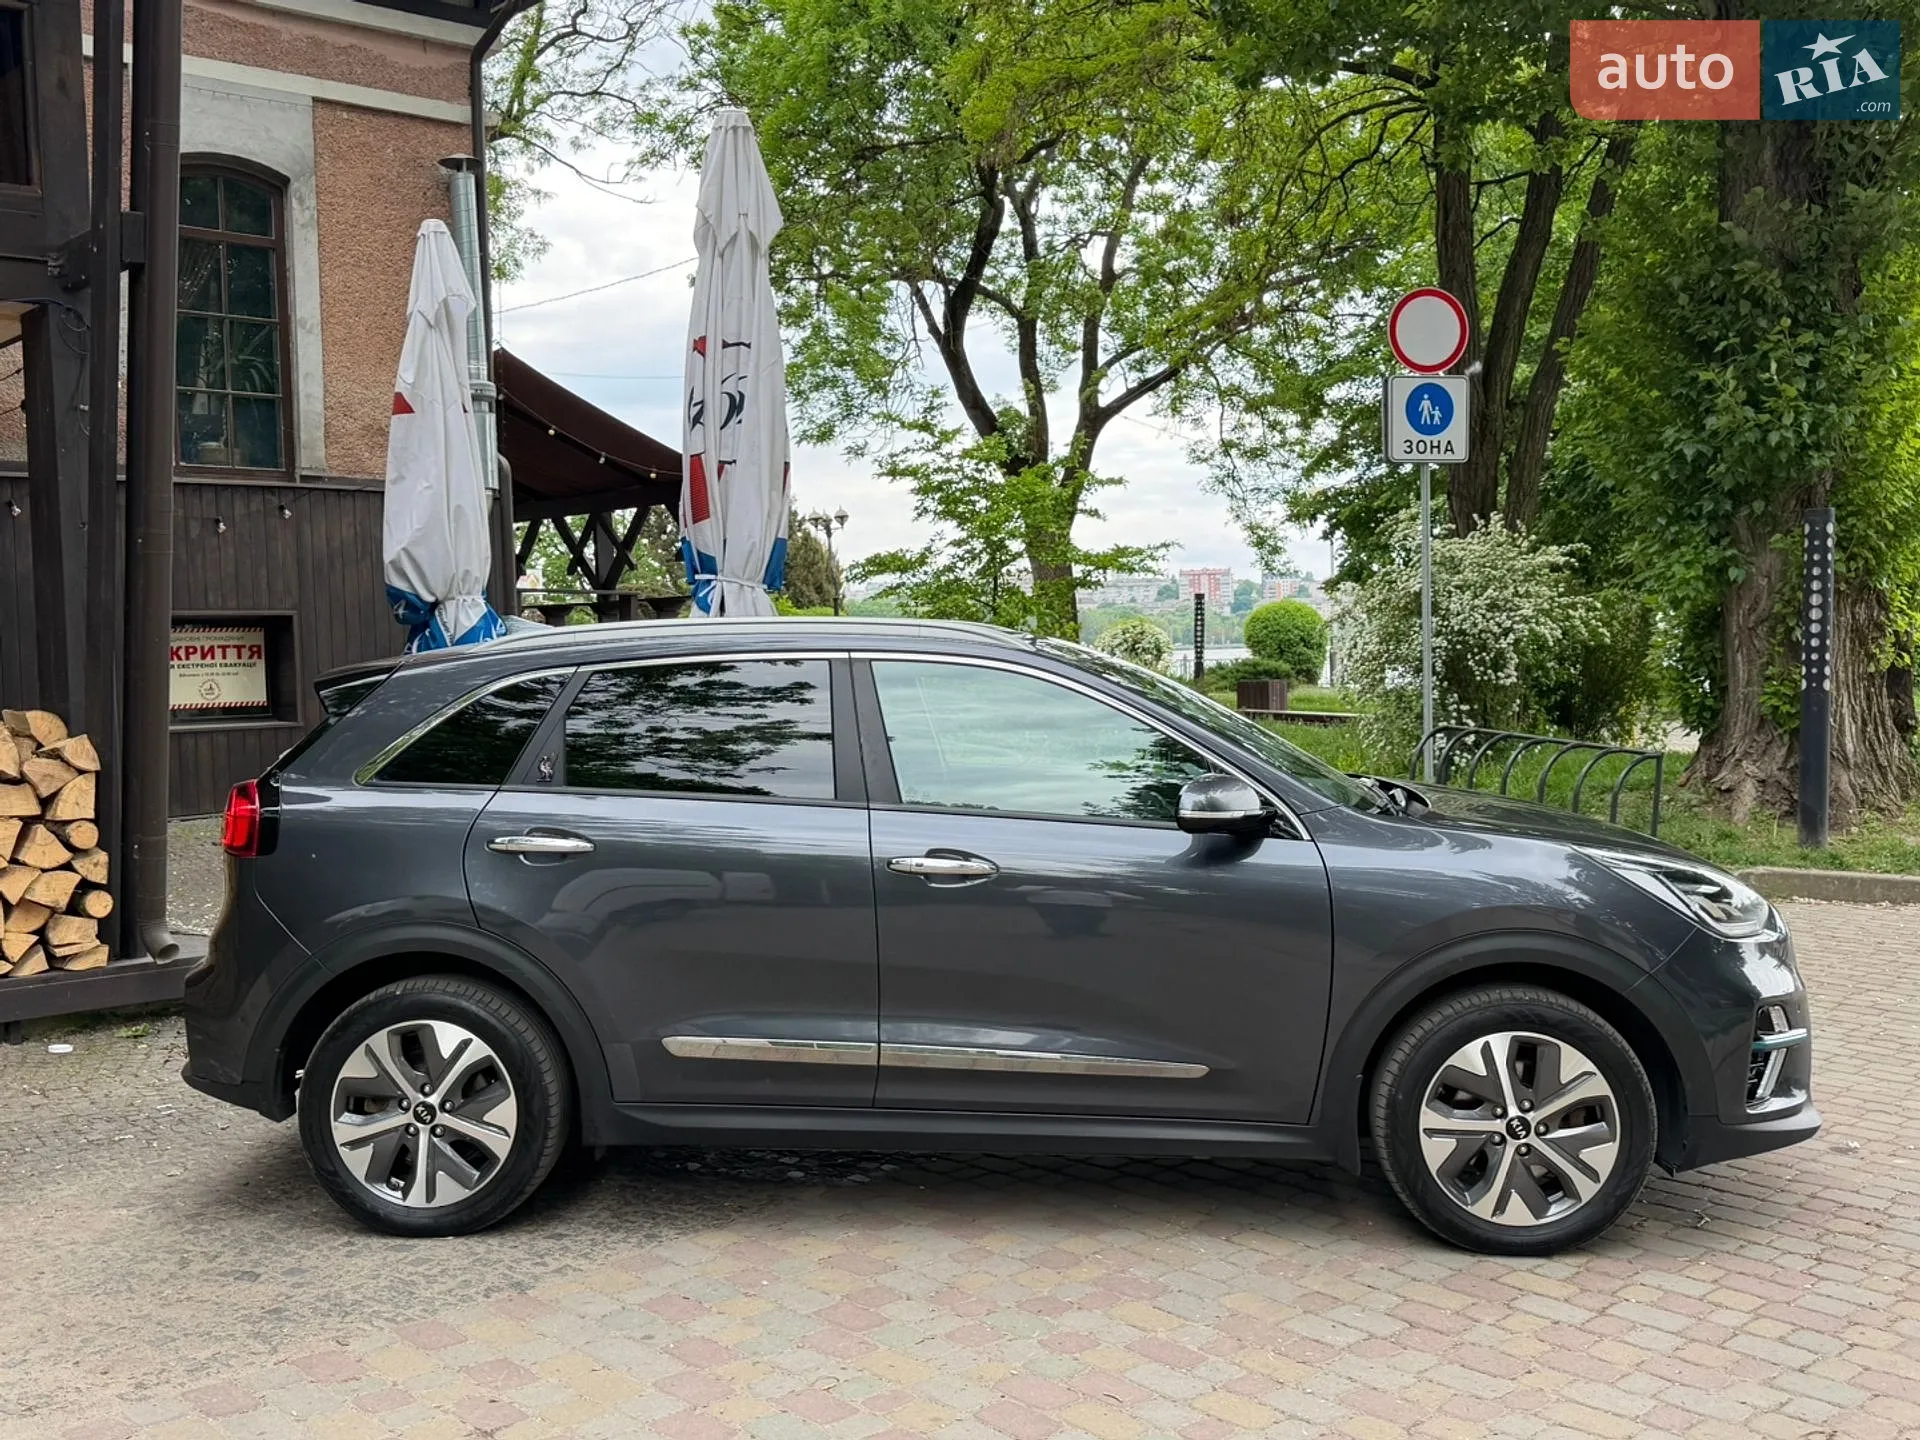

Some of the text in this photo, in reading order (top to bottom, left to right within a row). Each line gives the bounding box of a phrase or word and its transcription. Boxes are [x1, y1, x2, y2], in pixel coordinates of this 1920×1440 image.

[1403, 439, 1455, 455] ЗОНА
[170, 645, 262, 661] КРИТТЯ
[415, 1106, 431, 1123] KIA
[1510, 1118, 1527, 1139] KIA
